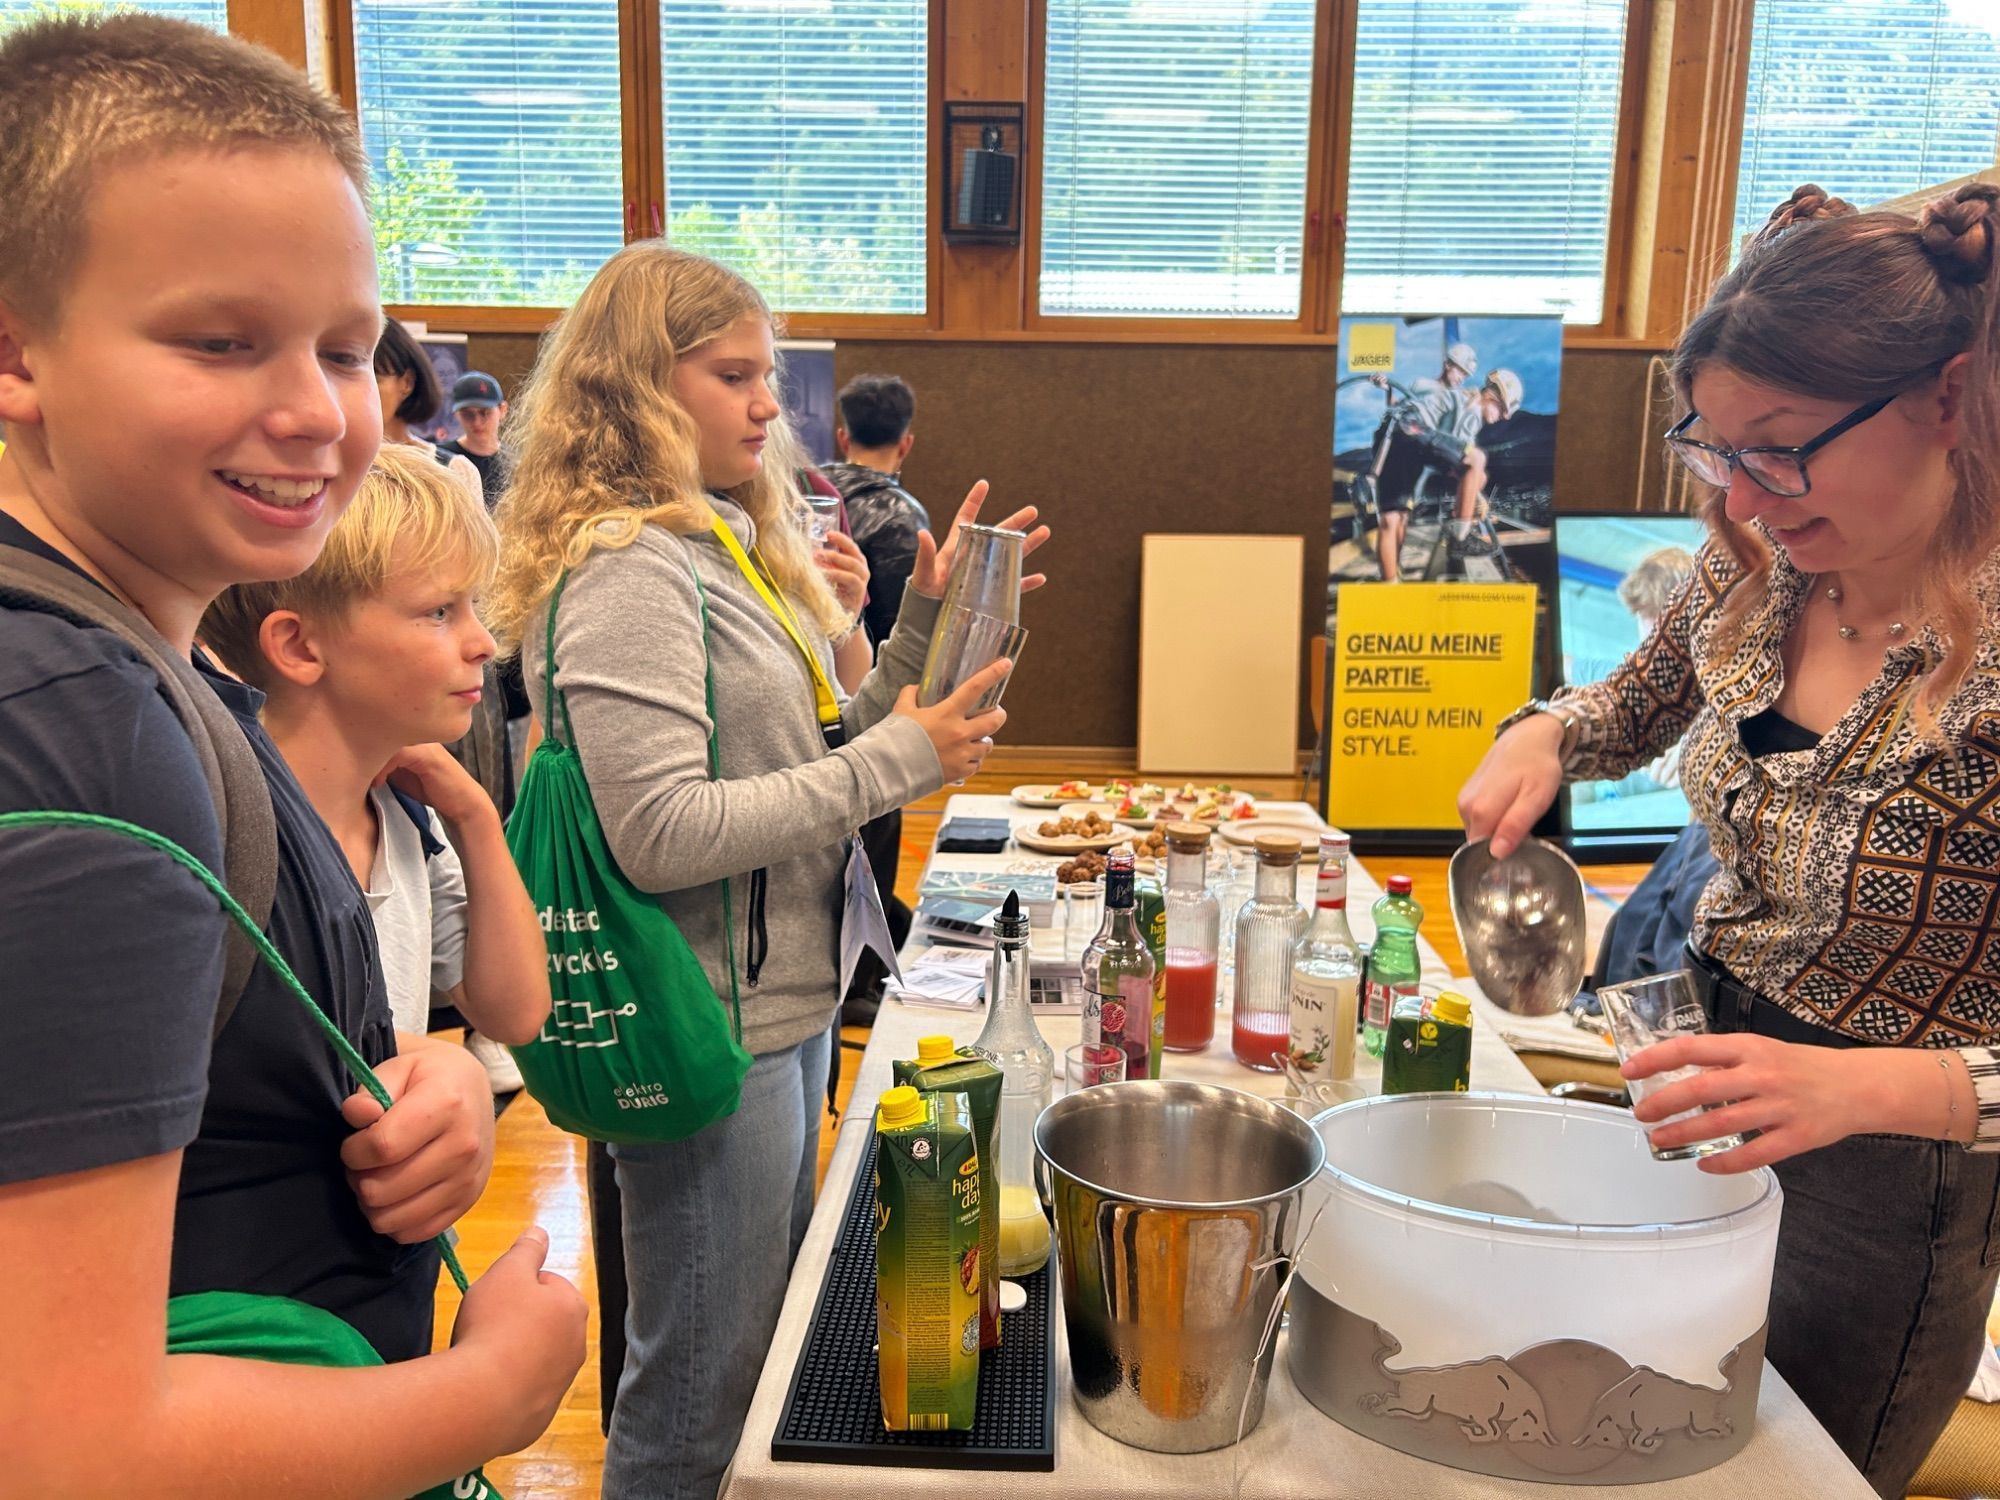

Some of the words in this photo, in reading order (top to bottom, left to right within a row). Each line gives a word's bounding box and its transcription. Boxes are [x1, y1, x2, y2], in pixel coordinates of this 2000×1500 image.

[1347, 634, 1423, 654] GENAU
[1431, 634, 1502, 654] MEINE
[1346, 667, 1430, 686] PARTIE.
[1344, 708, 1419, 728] GENAU
[1427, 709, 1482, 728] MEIN
[1342, 736, 1416, 756] STYLE.
[1292, 994, 1323, 1012] NIN
[952, 1171, 980, 1196] hap
